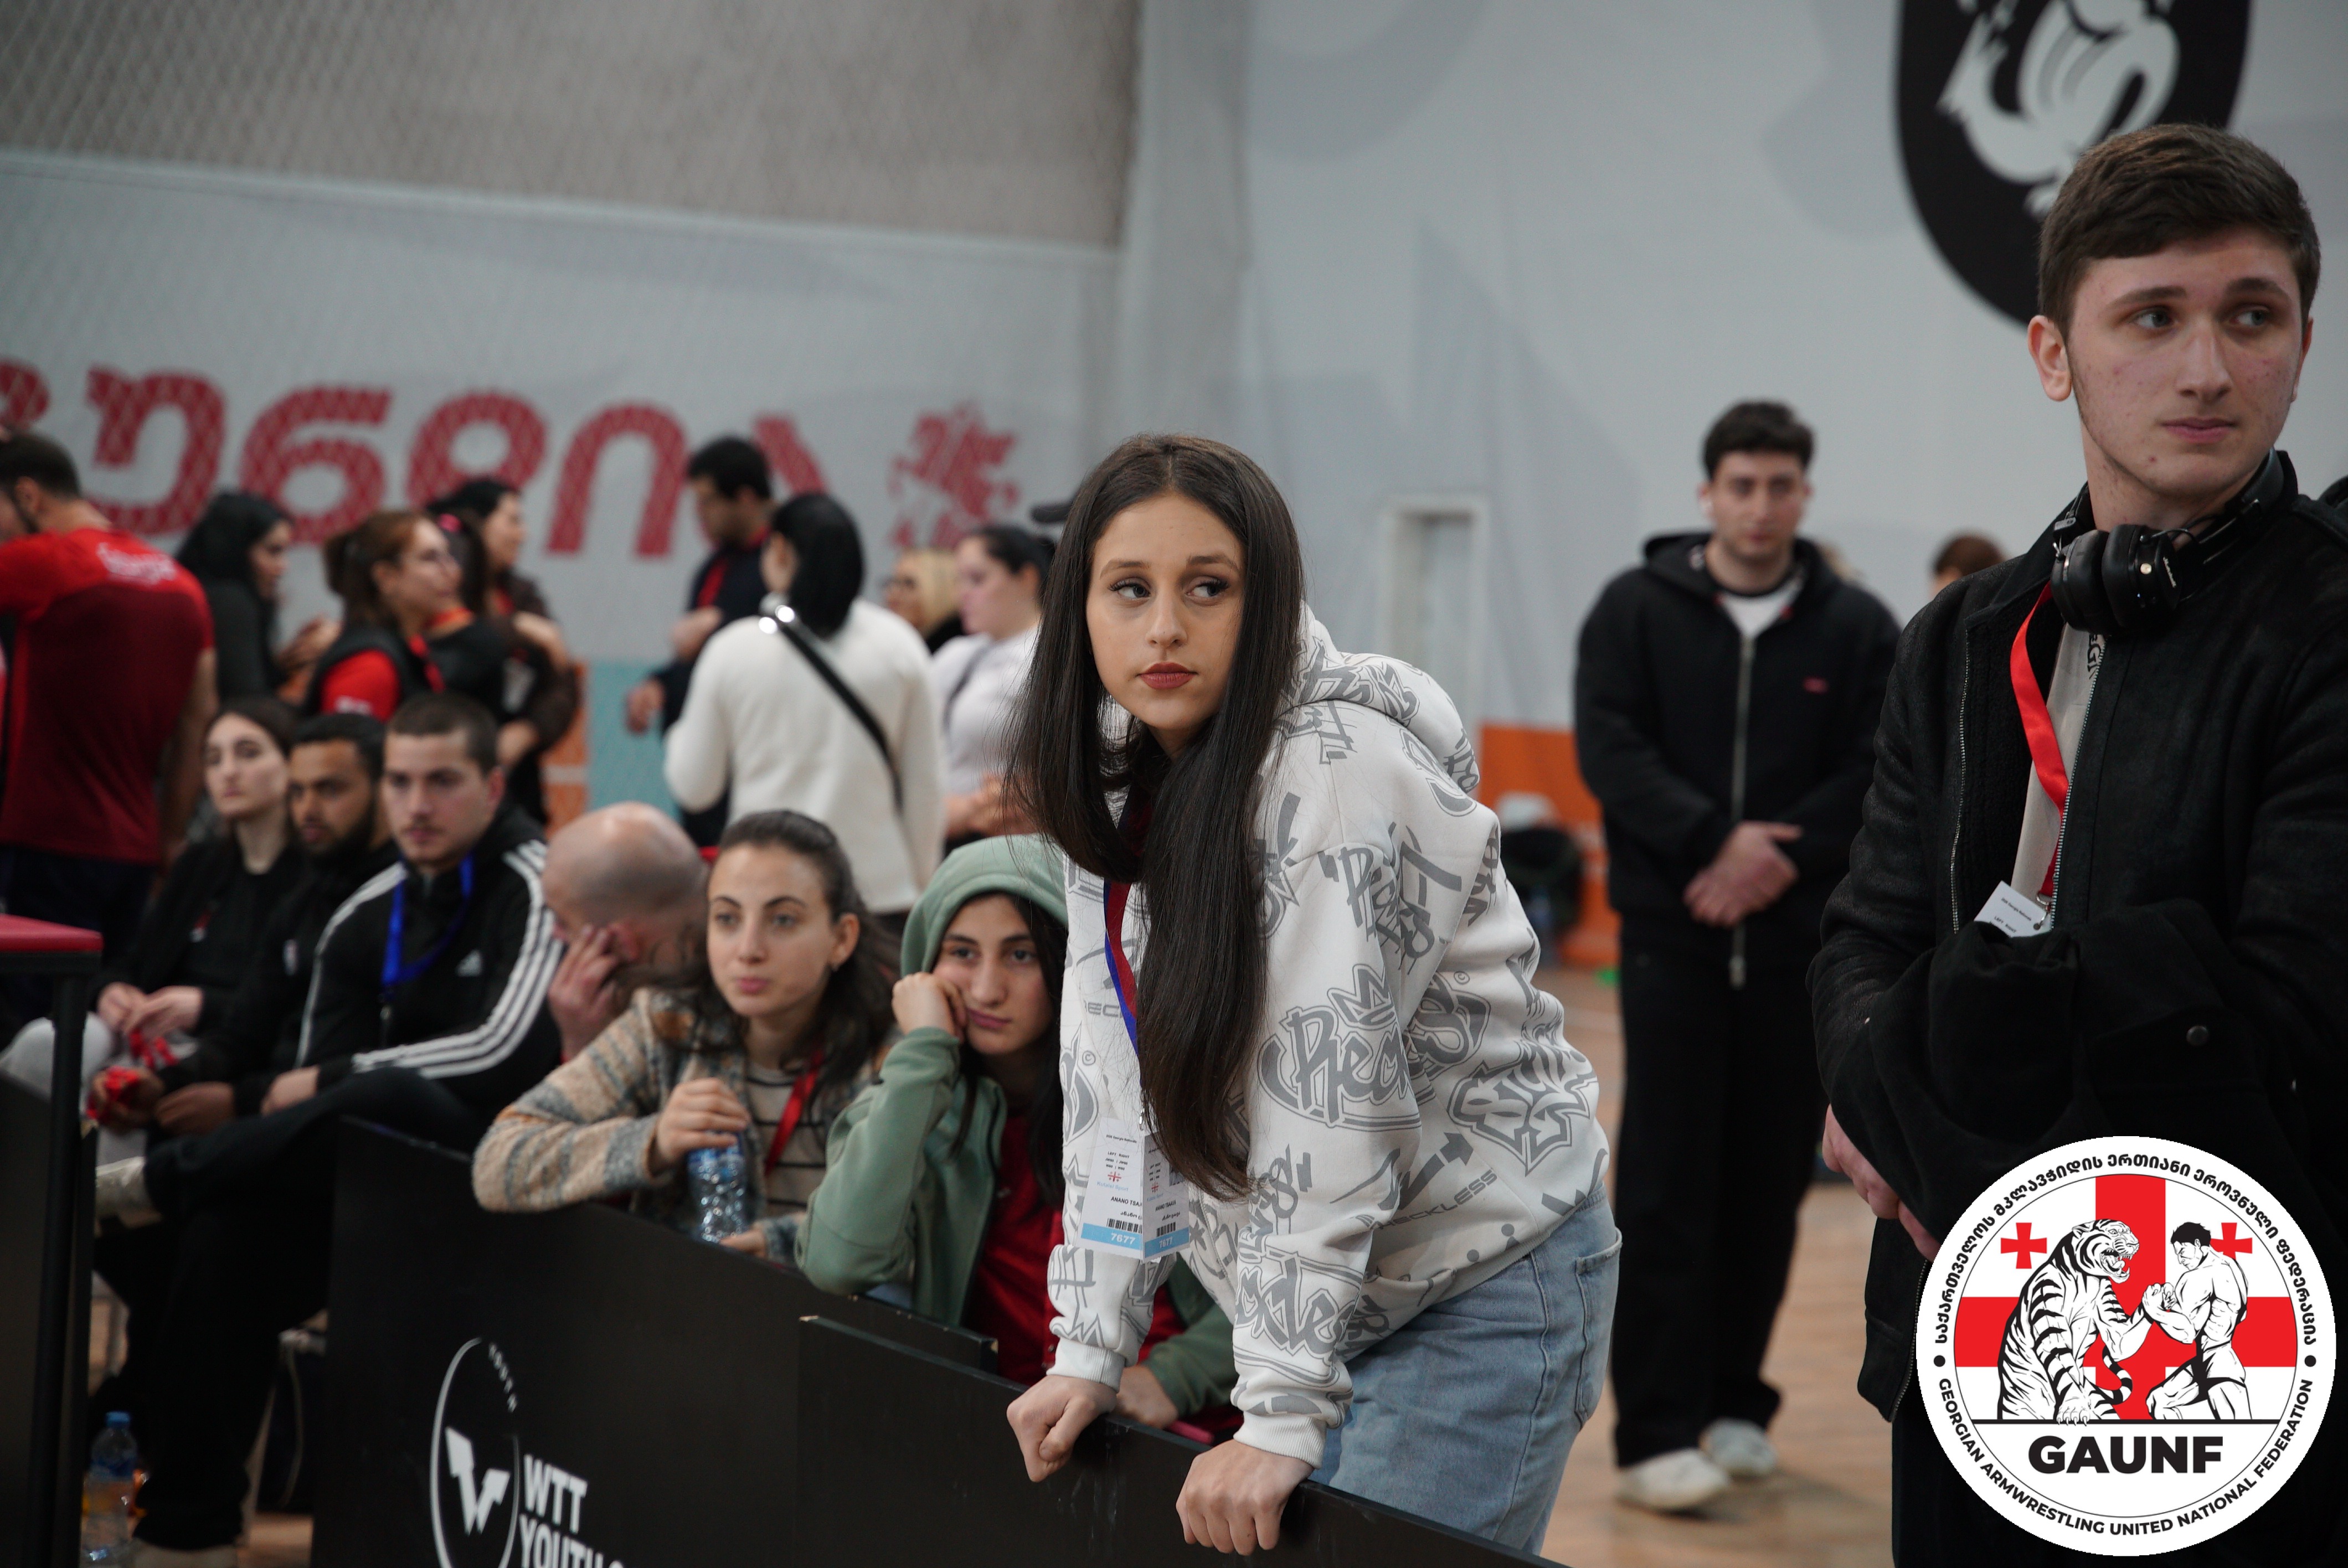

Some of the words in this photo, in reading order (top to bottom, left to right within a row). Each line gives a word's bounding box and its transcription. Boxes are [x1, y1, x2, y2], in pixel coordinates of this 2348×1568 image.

[1111, 1196, 1128, 1204] ANANO
[1111, 1232, 1135, 1245] 7677
[1159, 1236, 1172, 1249] 7677
[523, 1453, 589, 1534] WTT
